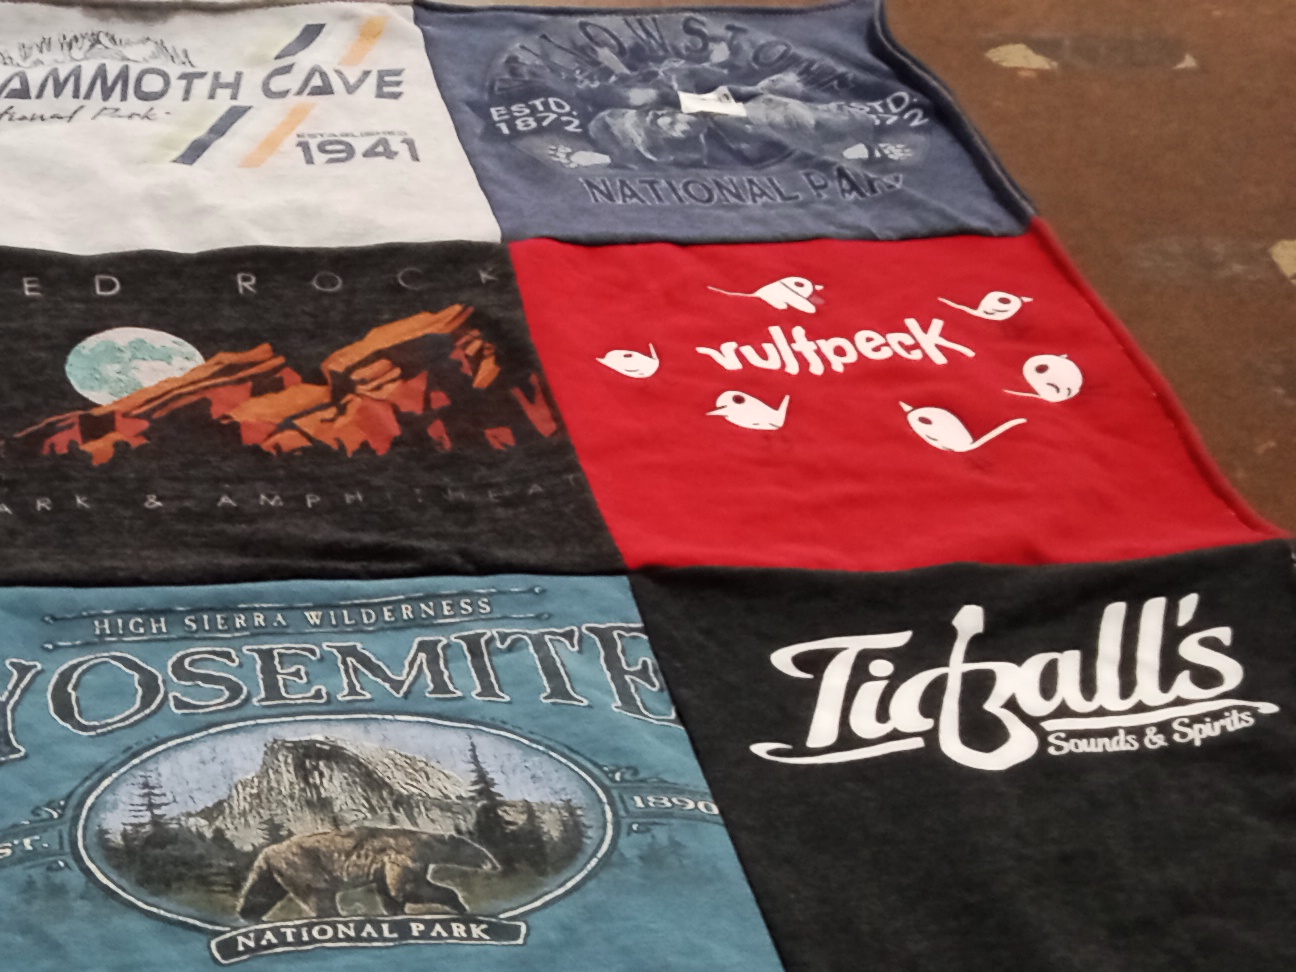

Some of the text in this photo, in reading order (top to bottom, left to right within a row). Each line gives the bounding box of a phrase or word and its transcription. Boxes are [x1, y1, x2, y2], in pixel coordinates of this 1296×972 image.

[260, 62, 406, 100] CAVE
[489, 97, 579, 123] ESTD.
[495, 111, 585, 135] 1872
[294, 136, 421, 166] 1941
[578, 174, 802, 206] NATIONAL
[236, 266, 498, 294] ROCK
[143, 494, 163, 508] &
[94, 597, 495, 637] HIGH SIERRA WILDERNESS
[1046, 708, 1256, 756] Sounds & Spirits
[633, 795, 720, 815] 1890
[235, 918, 492, 953] NATIONAL PARK
